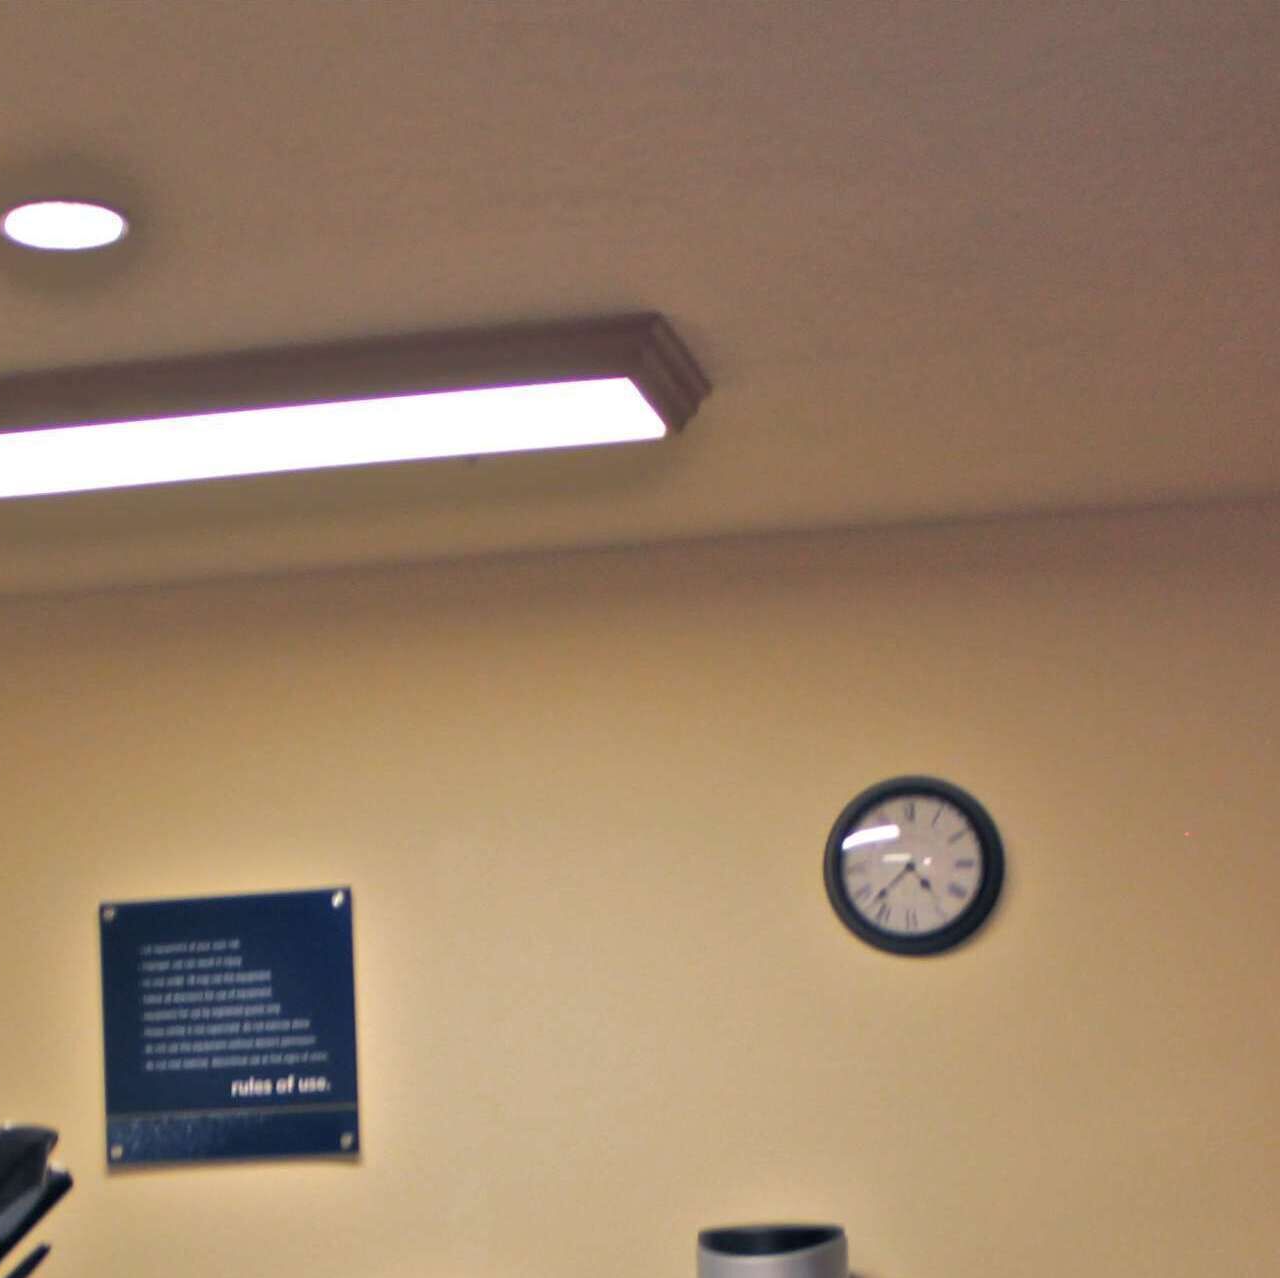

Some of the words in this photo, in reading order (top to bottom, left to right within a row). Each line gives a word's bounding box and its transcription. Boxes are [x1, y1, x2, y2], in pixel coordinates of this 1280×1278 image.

[231, 1076, 272, 1097] rules
[275, 1073, 295, 1094] of
[298, 1075, 331, 1093] use.
